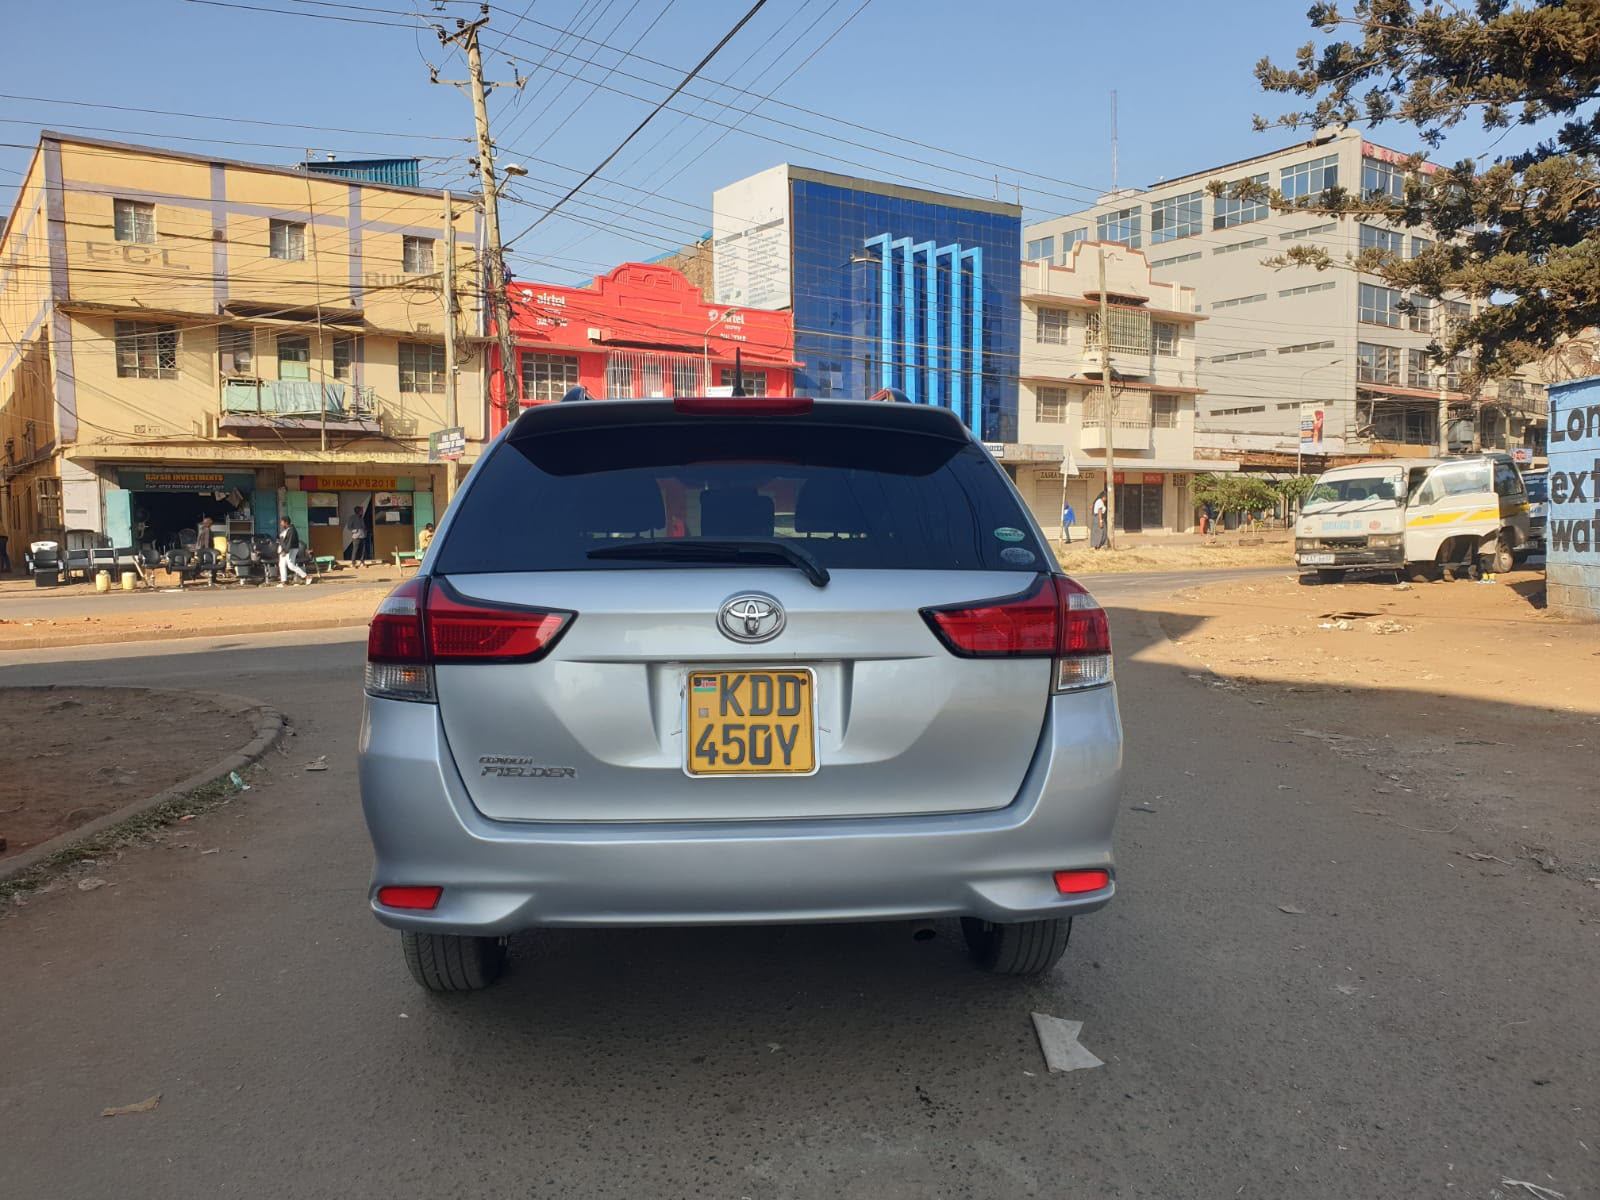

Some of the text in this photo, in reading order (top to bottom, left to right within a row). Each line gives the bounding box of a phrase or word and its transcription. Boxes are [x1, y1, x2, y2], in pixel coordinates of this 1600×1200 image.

[173, 473, 224, 481] INVESTMENTS
[720, 675, 801, 716] KDD
[695, 724, 799, 766] 450Y
[481, 766, 576, 779] FIELDER
